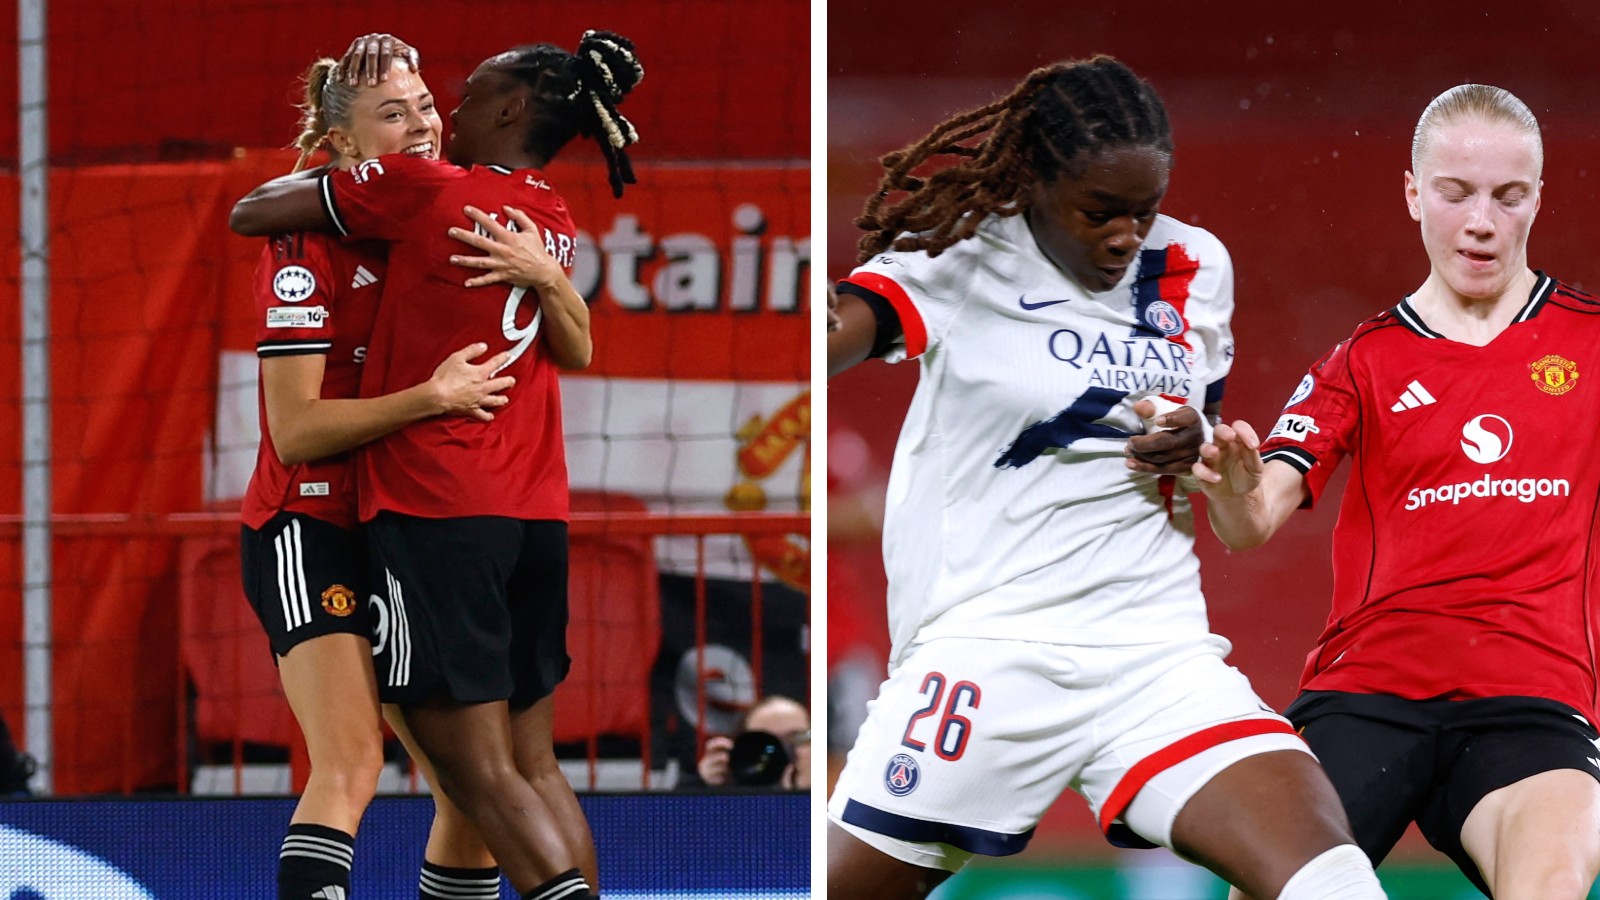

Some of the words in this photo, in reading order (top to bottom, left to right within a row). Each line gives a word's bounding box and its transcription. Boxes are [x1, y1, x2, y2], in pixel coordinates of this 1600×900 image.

[307, 311, 321, 322] 10
[490, 285, 542, 379] 9
[1047, 329, 1191, 374] QATAR
[1534, 357, 1573, 370] MANCHESTER
[1088, 368, 1192, 397] AIRWAYS
[1543, 385, 1570, 393] UNITED
[1286, 418, 1306, 433] 10
[1404, 474, 1569, 511] Snapdragon
[901, 671, 982, 762] 26
